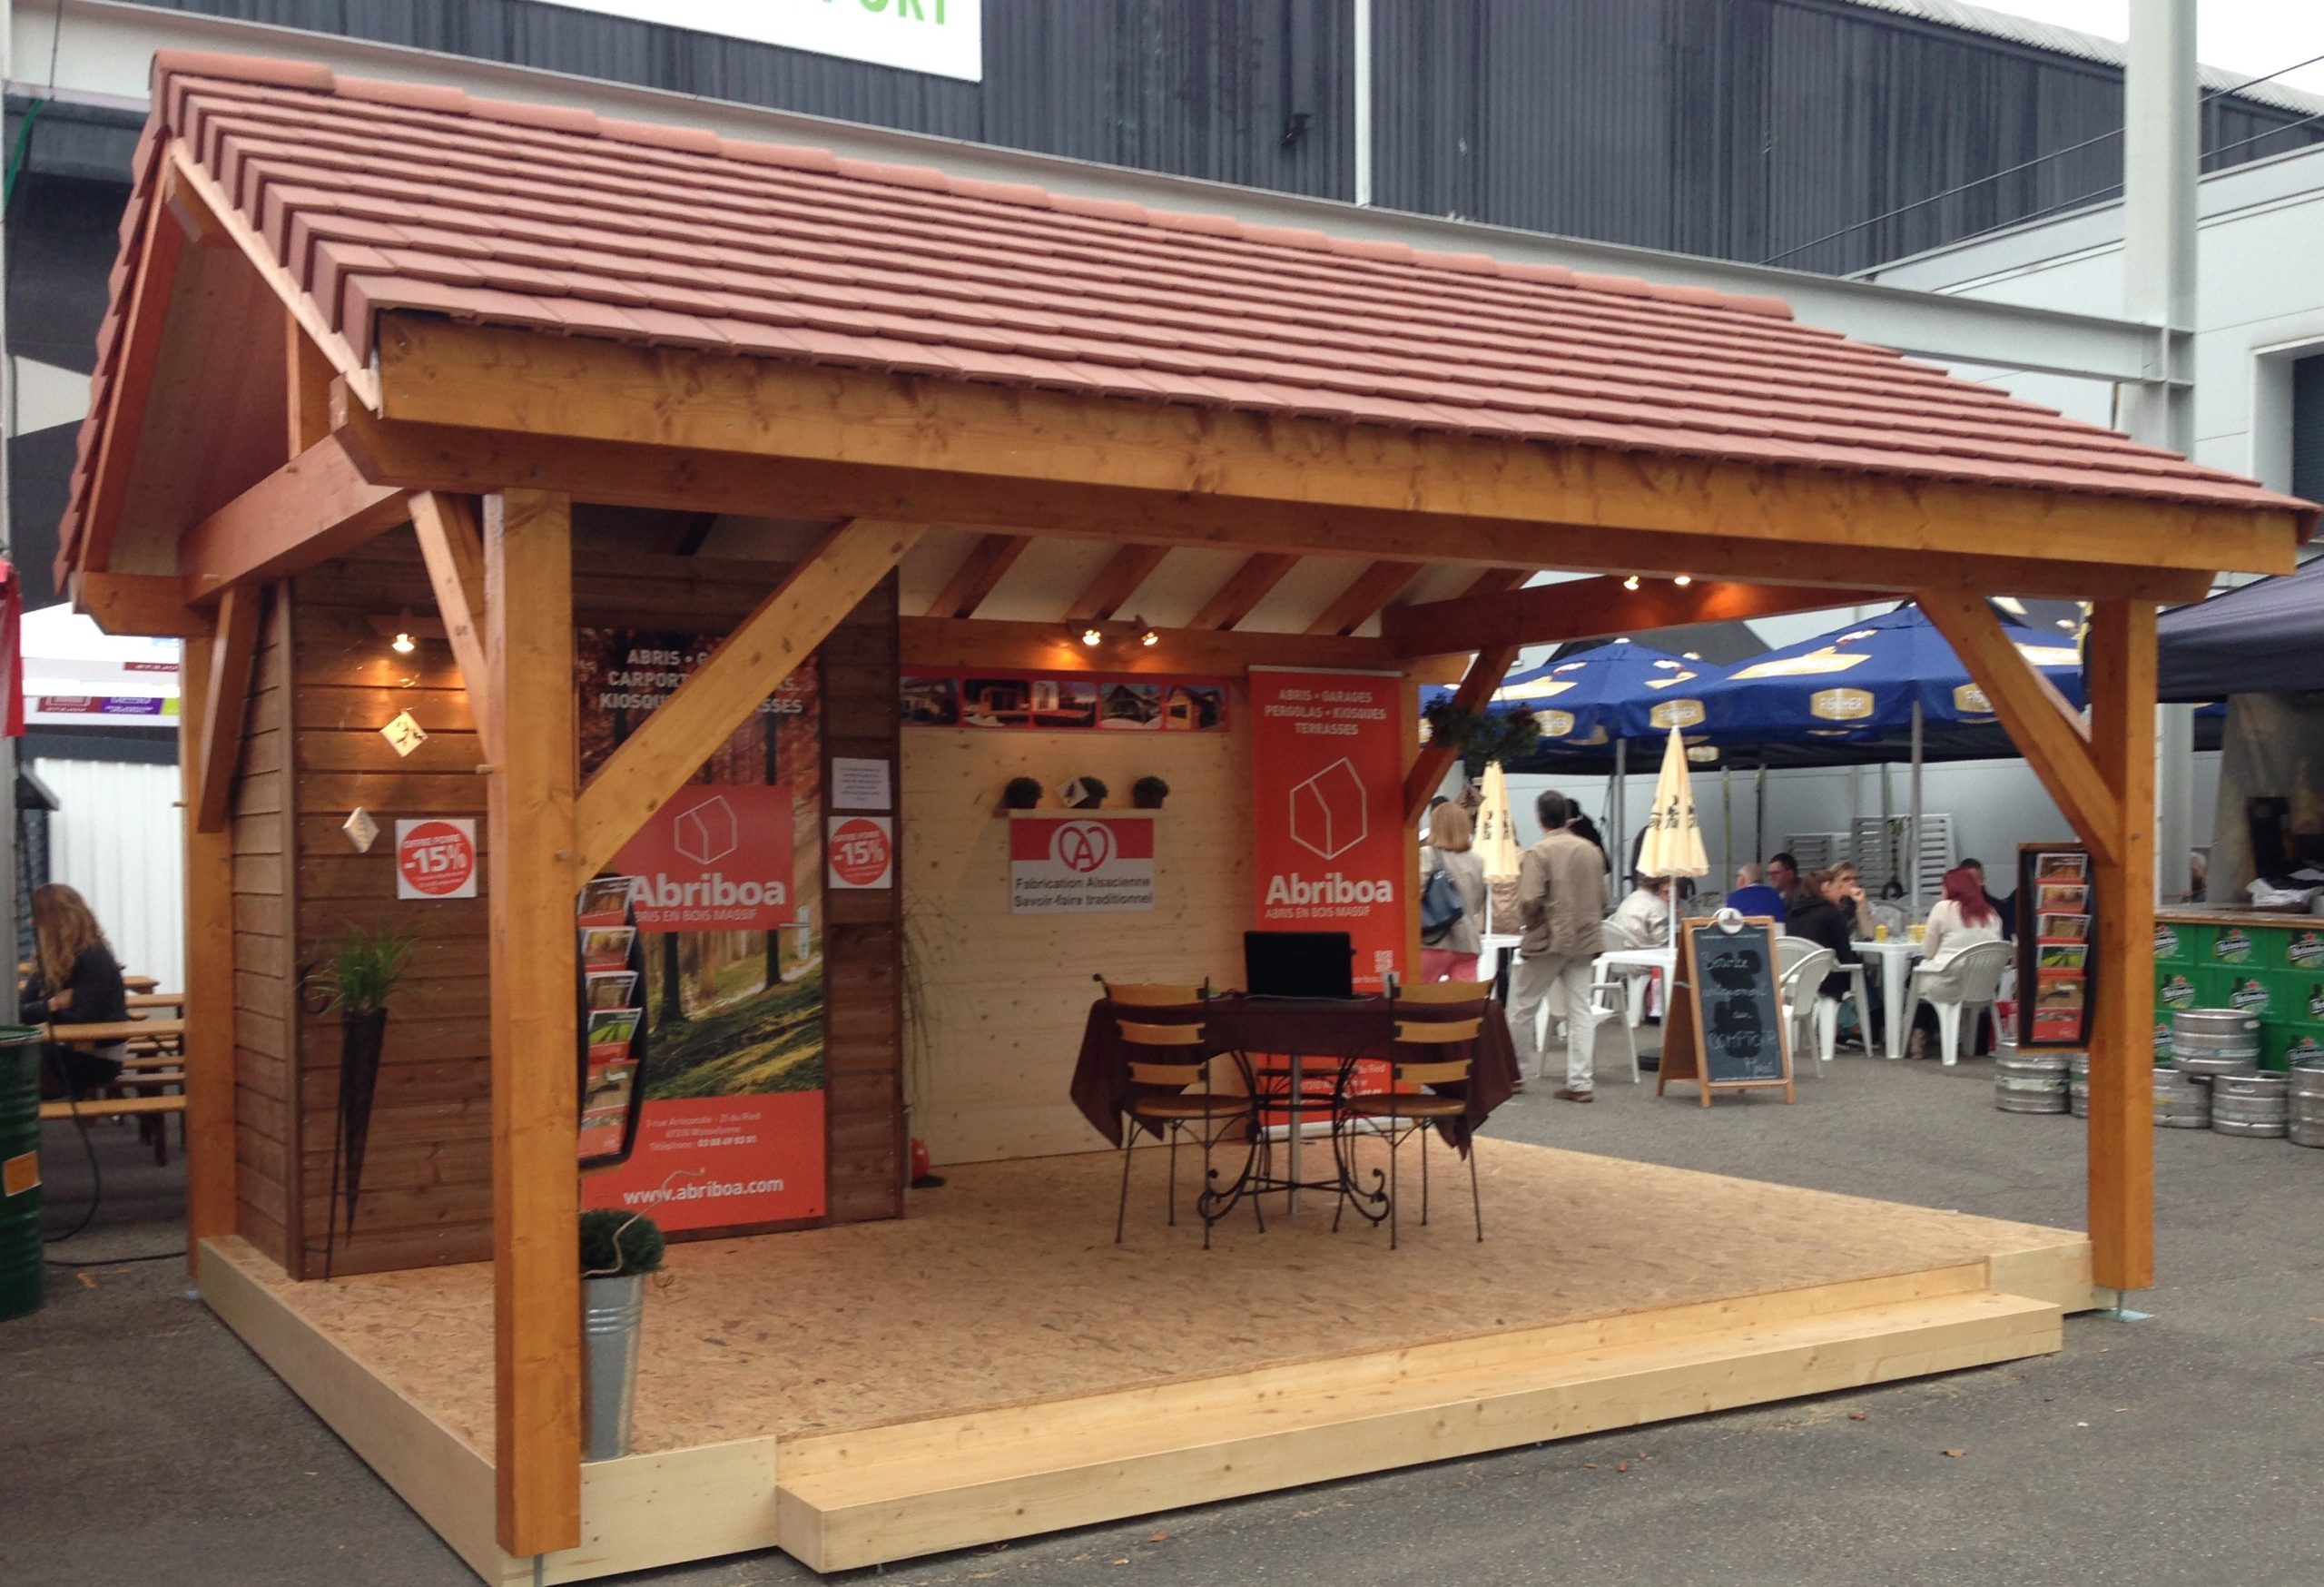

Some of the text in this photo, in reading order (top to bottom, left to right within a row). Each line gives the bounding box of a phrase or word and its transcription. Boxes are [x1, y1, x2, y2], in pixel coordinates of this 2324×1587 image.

[626, 649, 680, 665] ABRIS
[607, 671, 689, 687] CARPORT
[599, 693, 670, 709] KIOSQU
[1294, 723, 1358, 735] TERRASSES
[403, 843, 468, 873] -15%
[833, 839, 885, 865] -15%
[628, 872, 786, 907] Abriboa
[1016, 877, 1083, 889] Fabrication
[1265, 872, 1393, 905] Abriboa
[1014, 892, 1153, 907] Savoir-faire traditionnel
[635, 910, 661, 922] BRIS
[624, 1179, 784, 1205] www.abriboa.com
